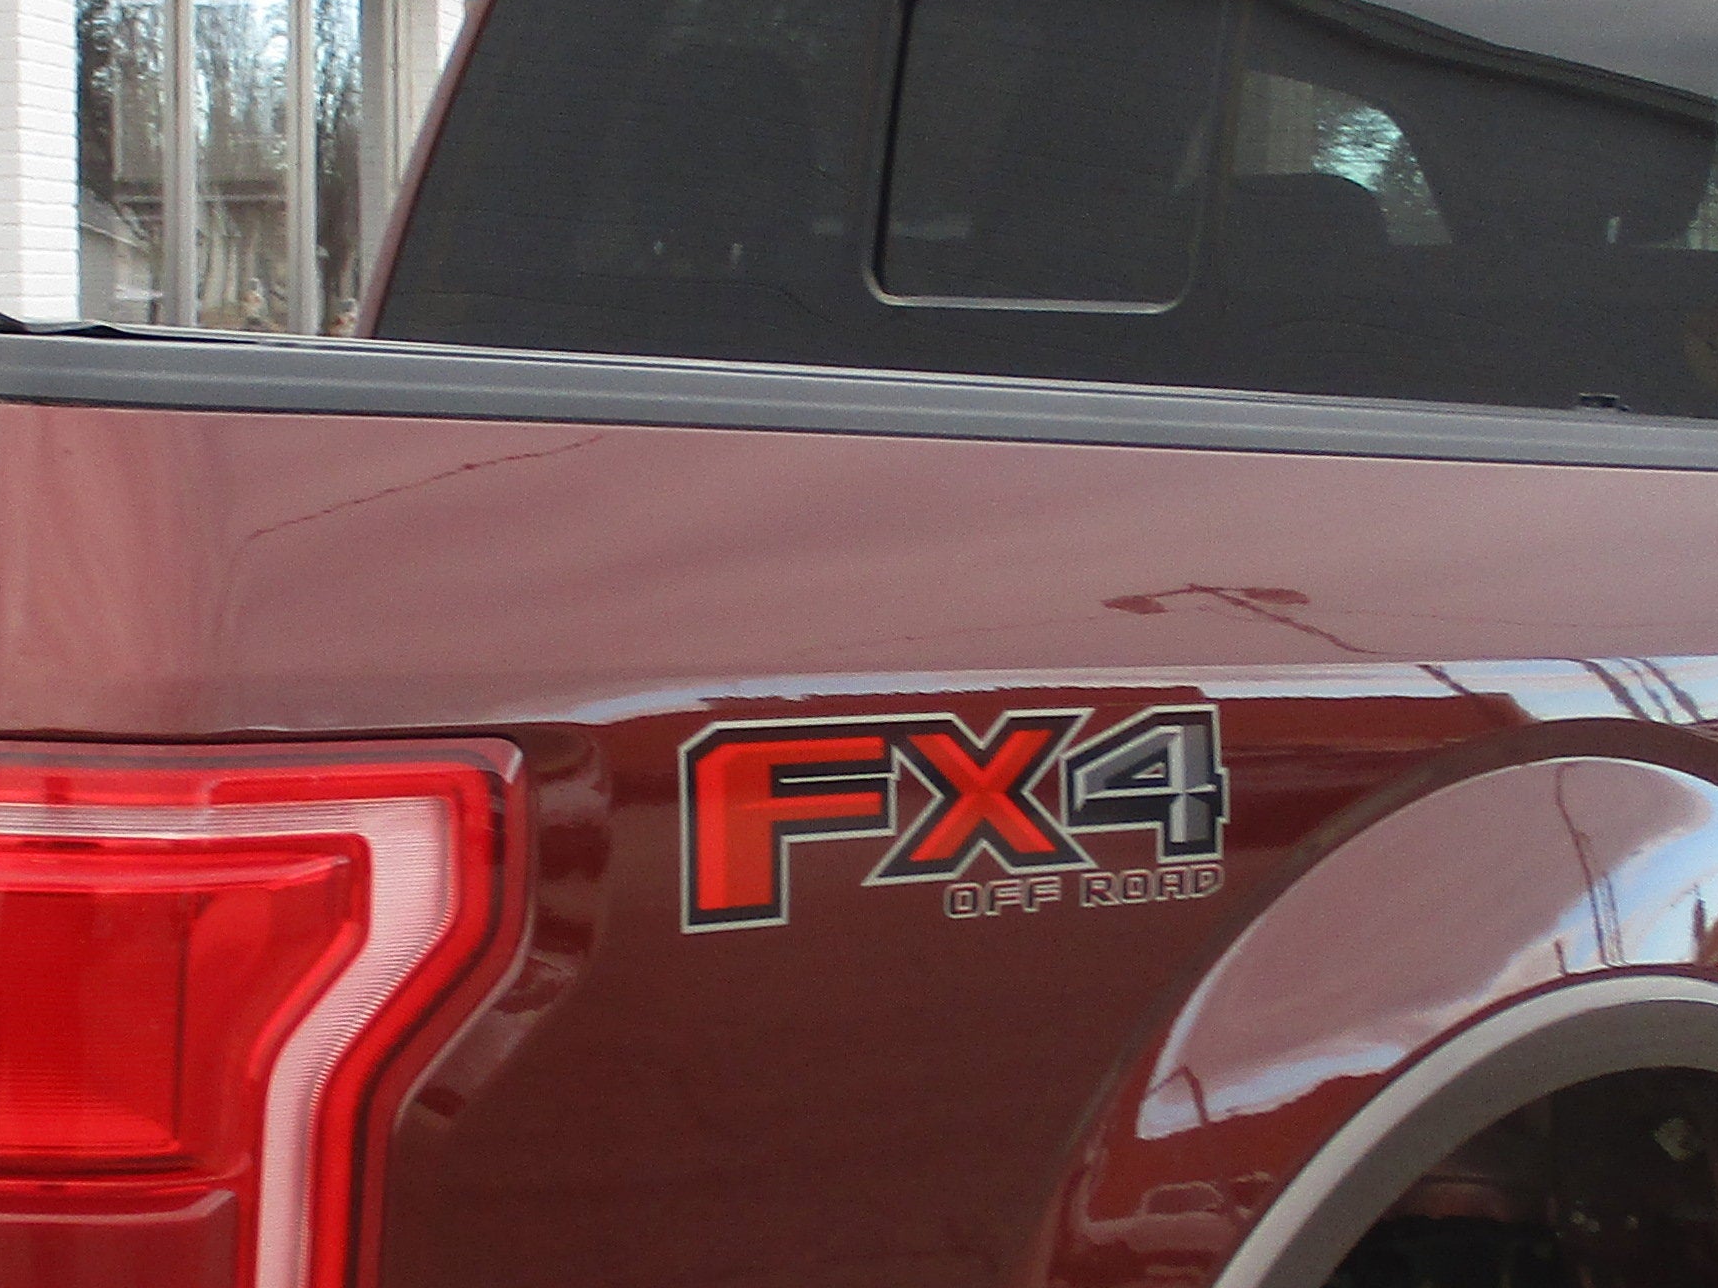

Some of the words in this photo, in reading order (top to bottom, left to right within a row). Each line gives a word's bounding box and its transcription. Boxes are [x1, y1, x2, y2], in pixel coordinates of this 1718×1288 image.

[678, 705, 1229, 934] FX4
[943, 874, 1062, 918] OFF
[1079, 862, 1224, 908] ROAD
